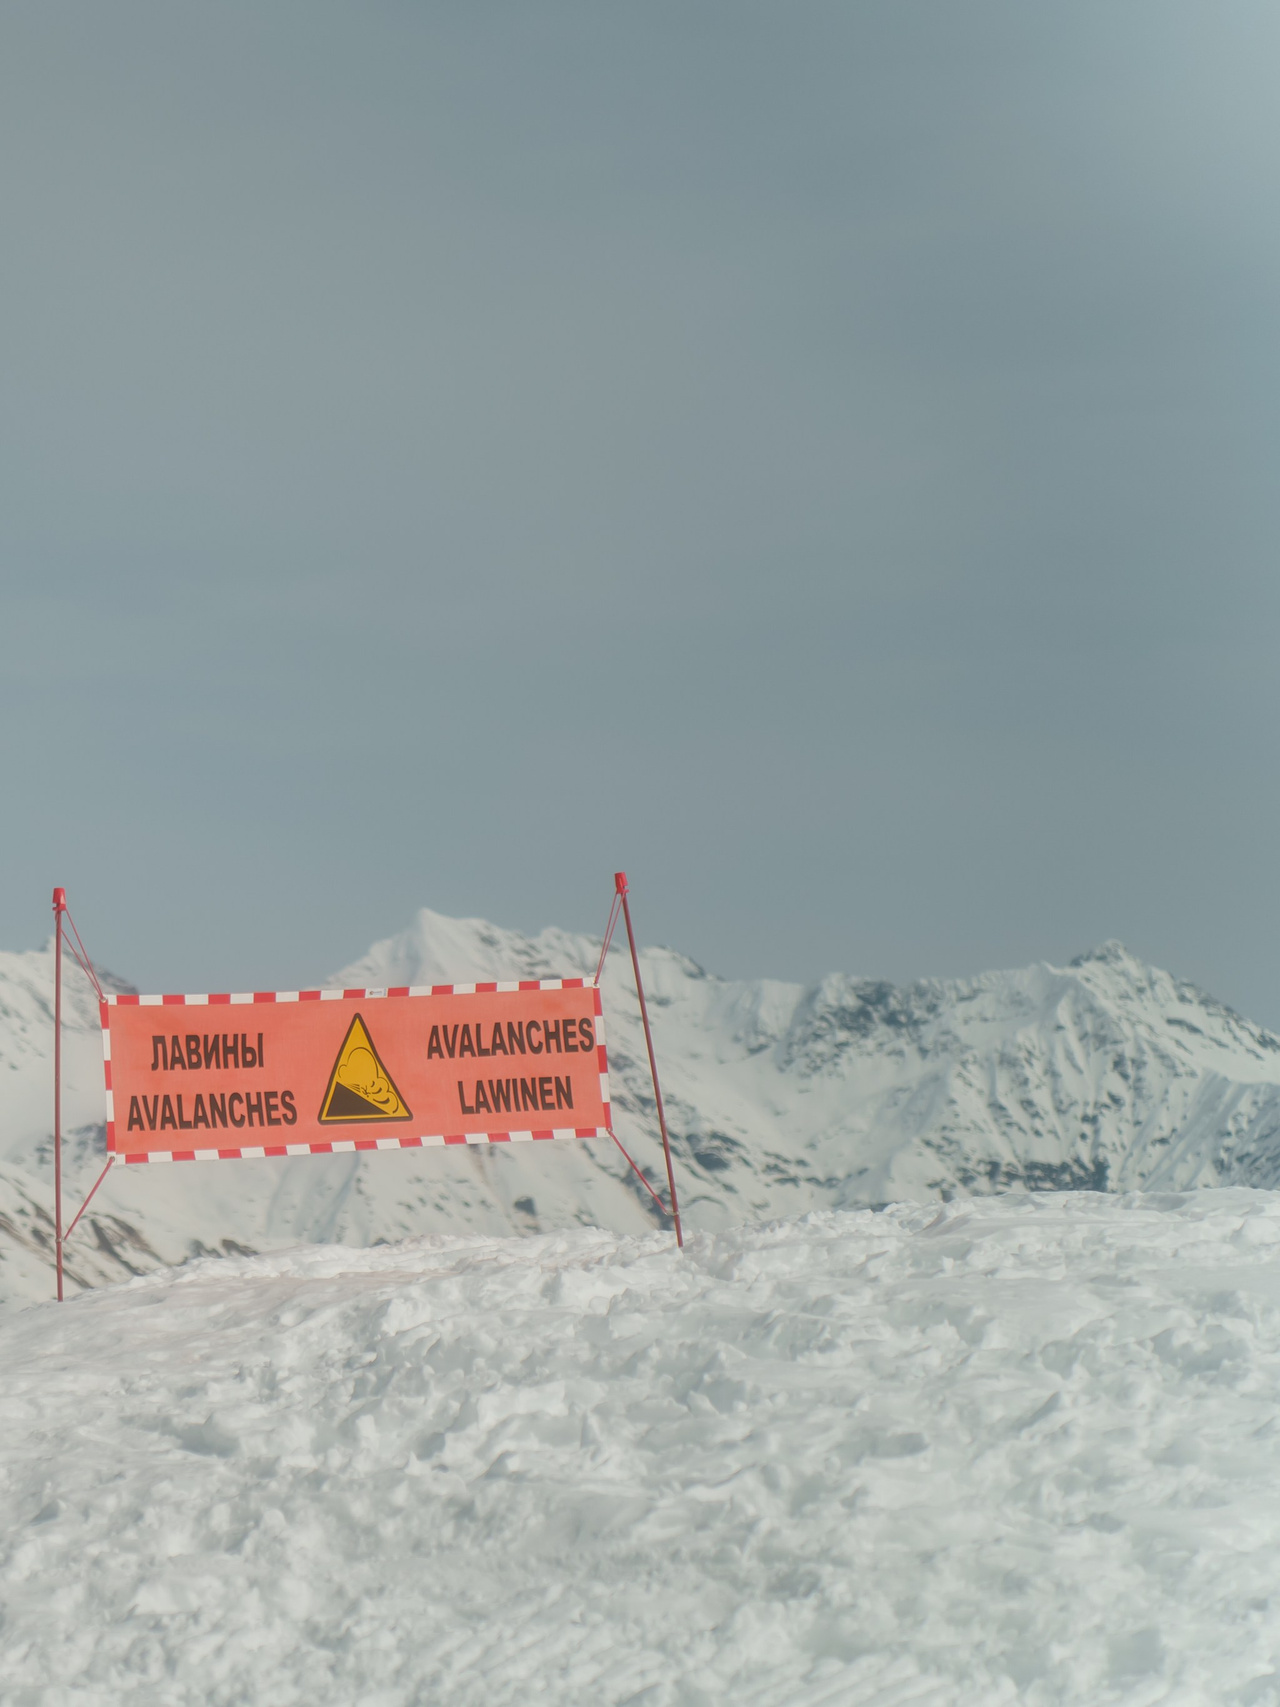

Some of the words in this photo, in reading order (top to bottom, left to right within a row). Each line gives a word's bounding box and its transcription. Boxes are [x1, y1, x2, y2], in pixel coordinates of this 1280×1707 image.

[151, 1032, 264, 1071] ЛАВИНЫ
[427, 1018, 595, 1060] AVALANCHES
[127, 1090, 298, 1132] AVALANCHES
[457, 1075, 574, 1115] LAWINEN
